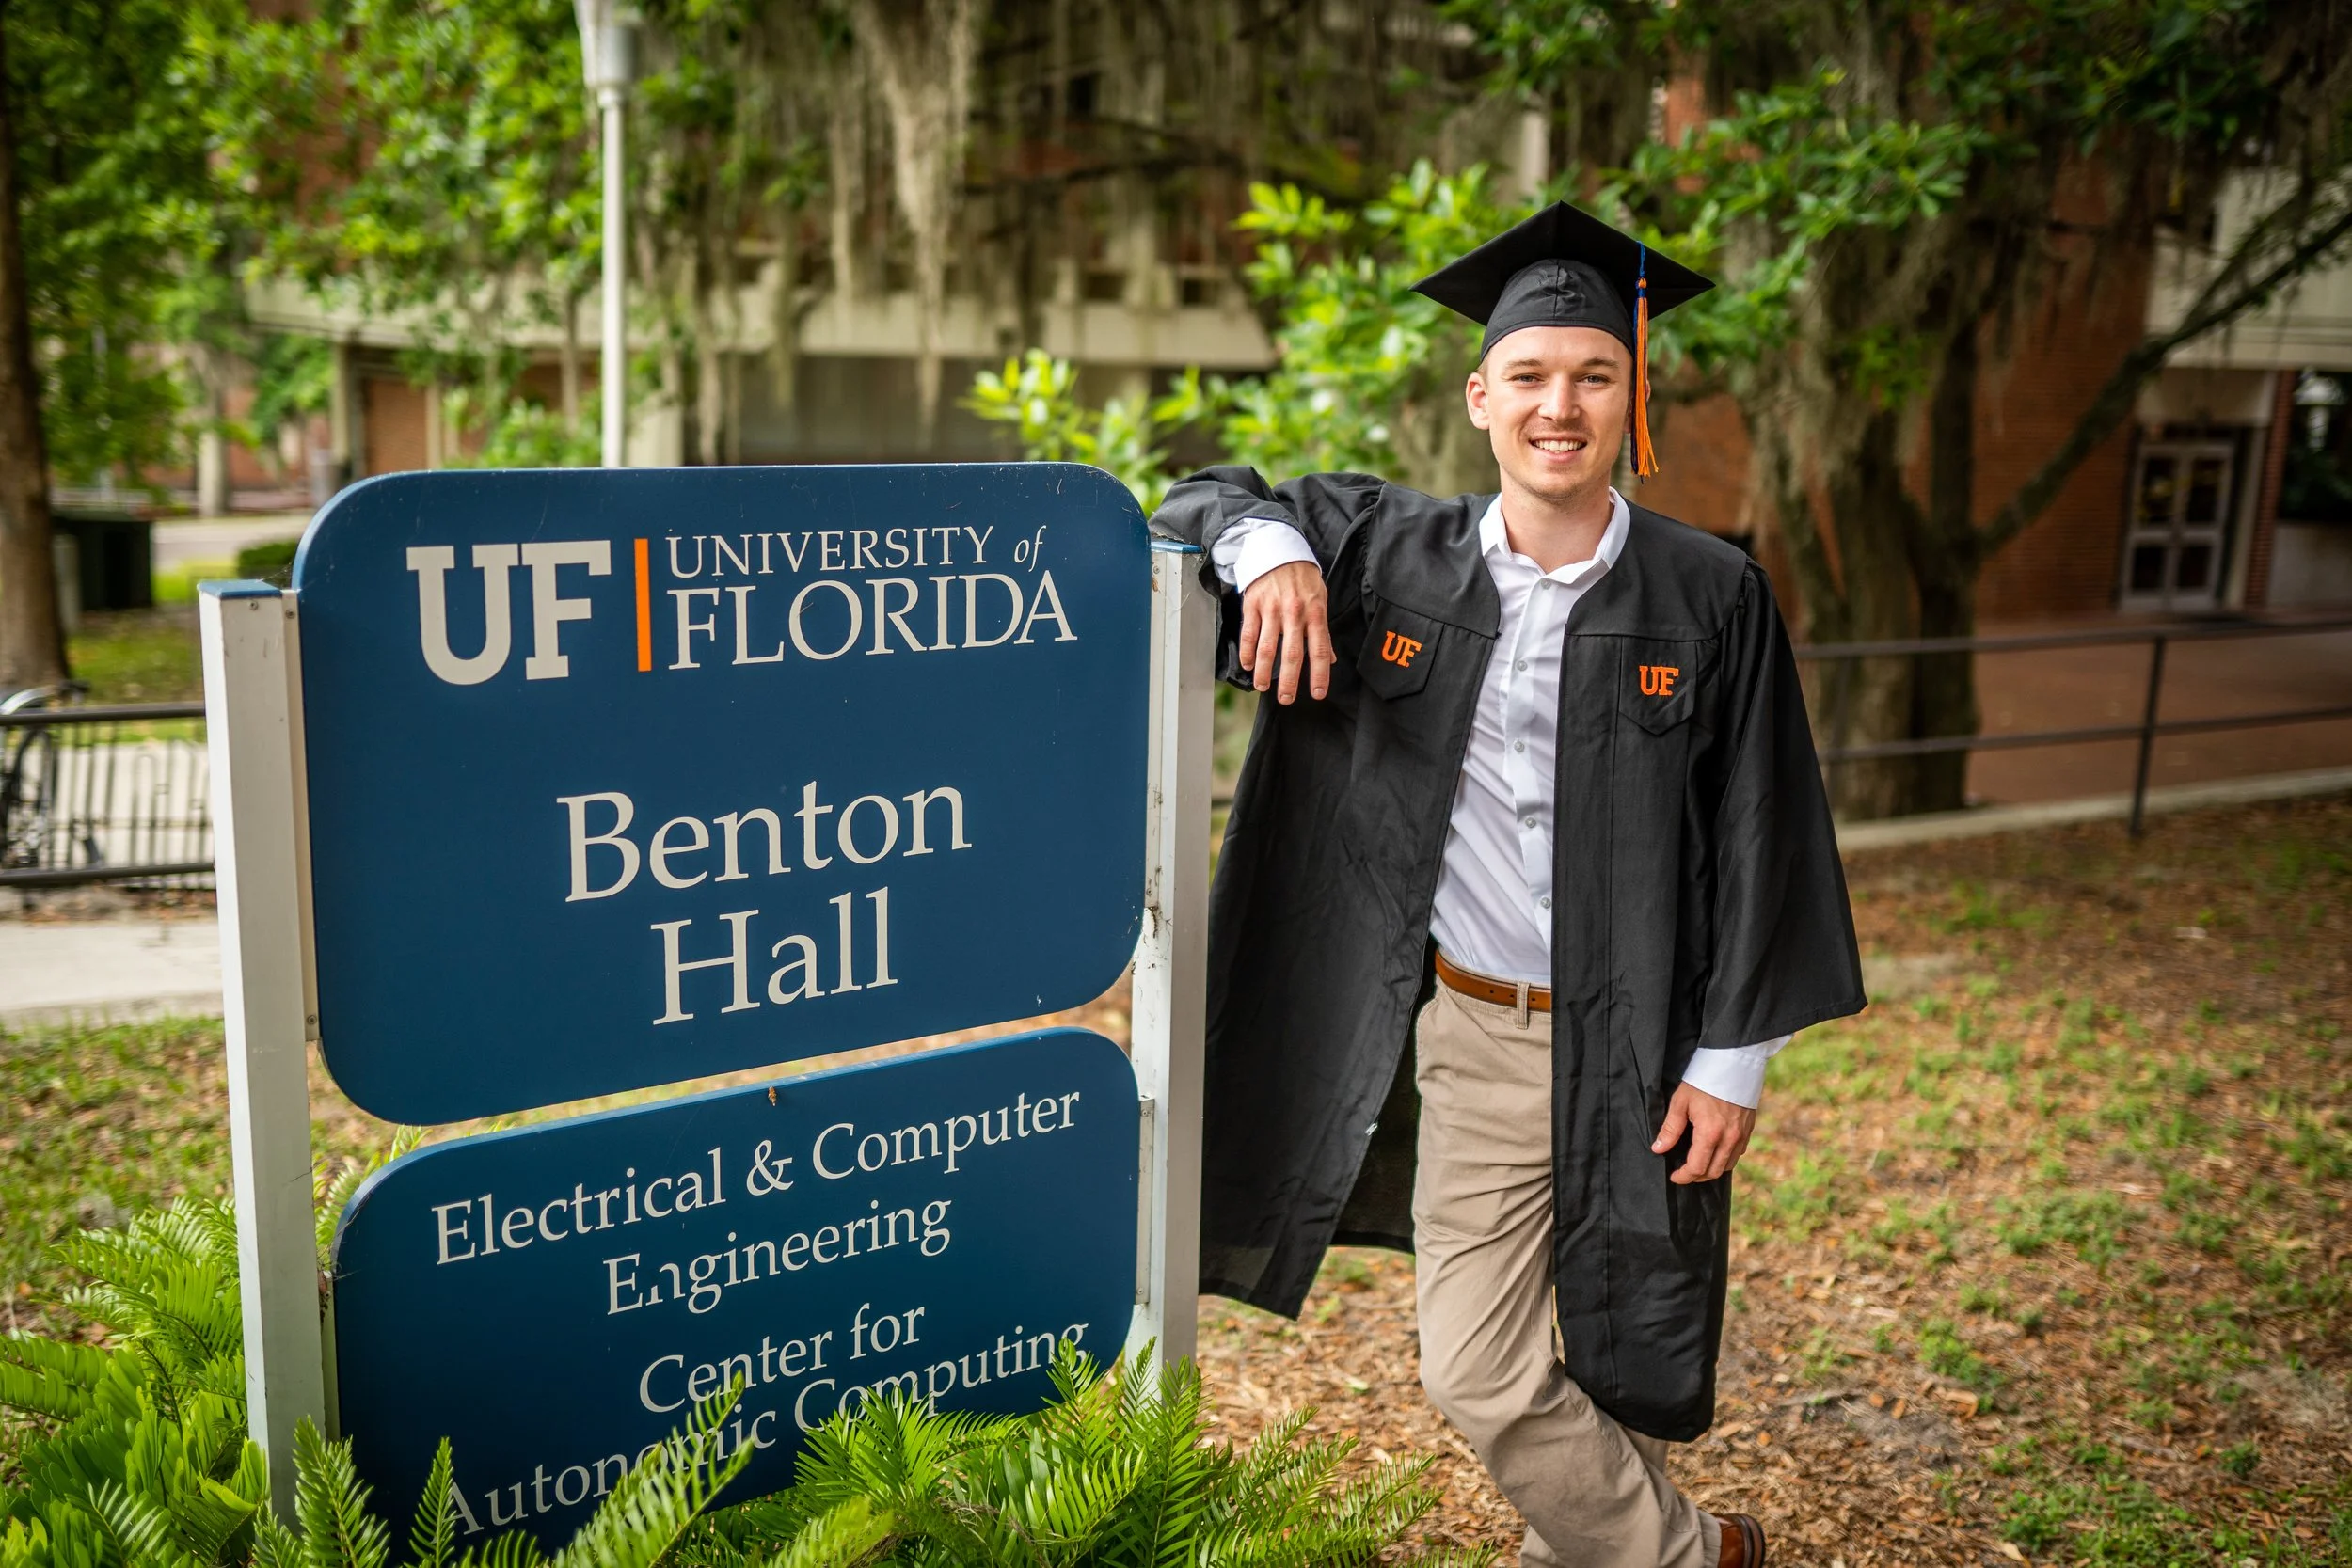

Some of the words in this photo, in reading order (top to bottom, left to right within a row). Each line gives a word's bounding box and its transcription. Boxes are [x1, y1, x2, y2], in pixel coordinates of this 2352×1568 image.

[667, 526, 993, 579] UNIVERSITY
[1014, 525, 1047, 571] of
[406, 540, 612, 685] UF
[667, 570, 1078, 670] FLORIDA
[1381, 631, 1422, 668] UF
[1639, 665, 1679, 696] UF
[556, 781, 973, 903] Benton
[651, 886, 898, 1026] Hall
[432, 1147, 726, 1265] Electrical
[746, 1139, 794, 1196] &
[812, 1091, 1080, 1174] Computer
[603, 1199, 952, 1315] Engineering
[640, 1330, 833, 1412] Center
[850, 1302, 926, 1360] for
